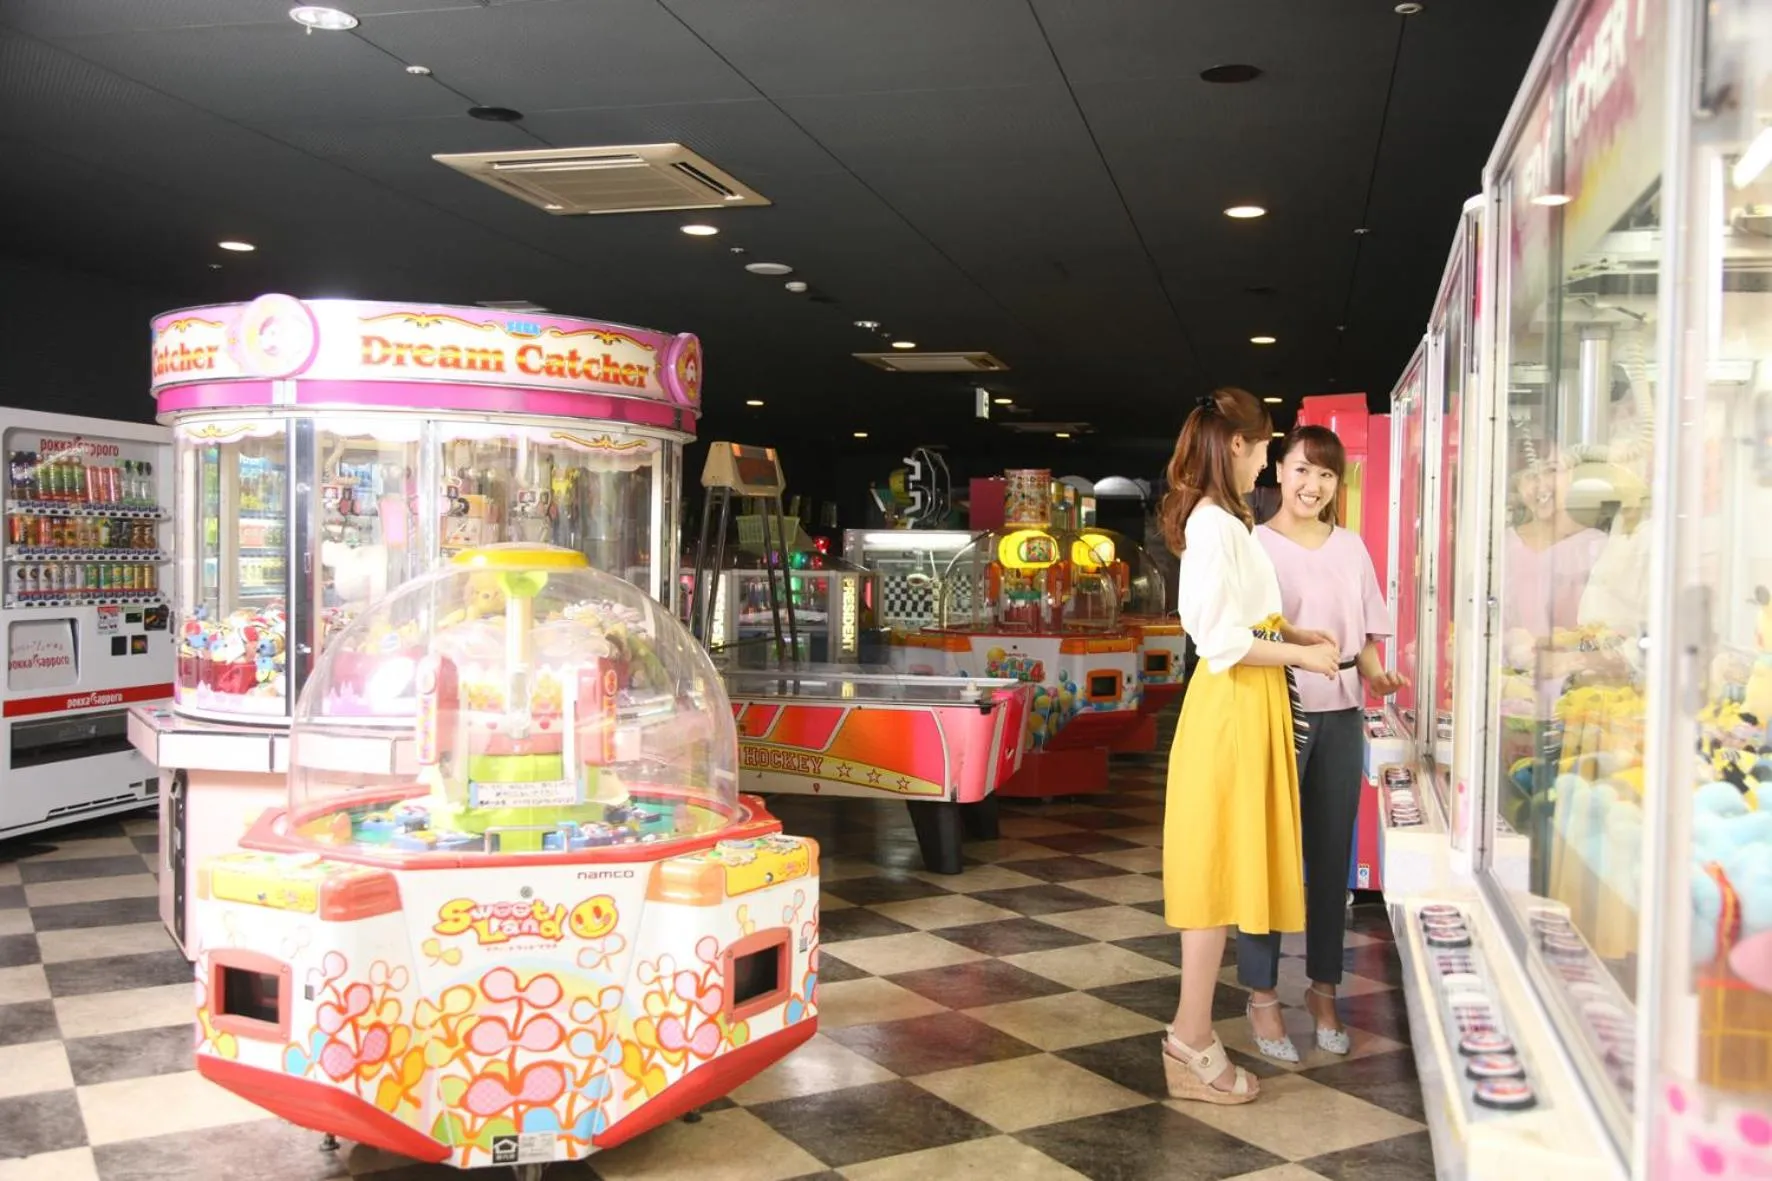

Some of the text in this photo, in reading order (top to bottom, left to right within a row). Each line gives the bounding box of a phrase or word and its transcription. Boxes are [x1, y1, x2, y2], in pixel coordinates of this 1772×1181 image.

[360, 335, 650, 389] Dream Catcher
[842, 577, 855, 652] PRESIDENT
[744, 746, 824, 775] HOCKEY
[577, 869, 634, 880] namco
